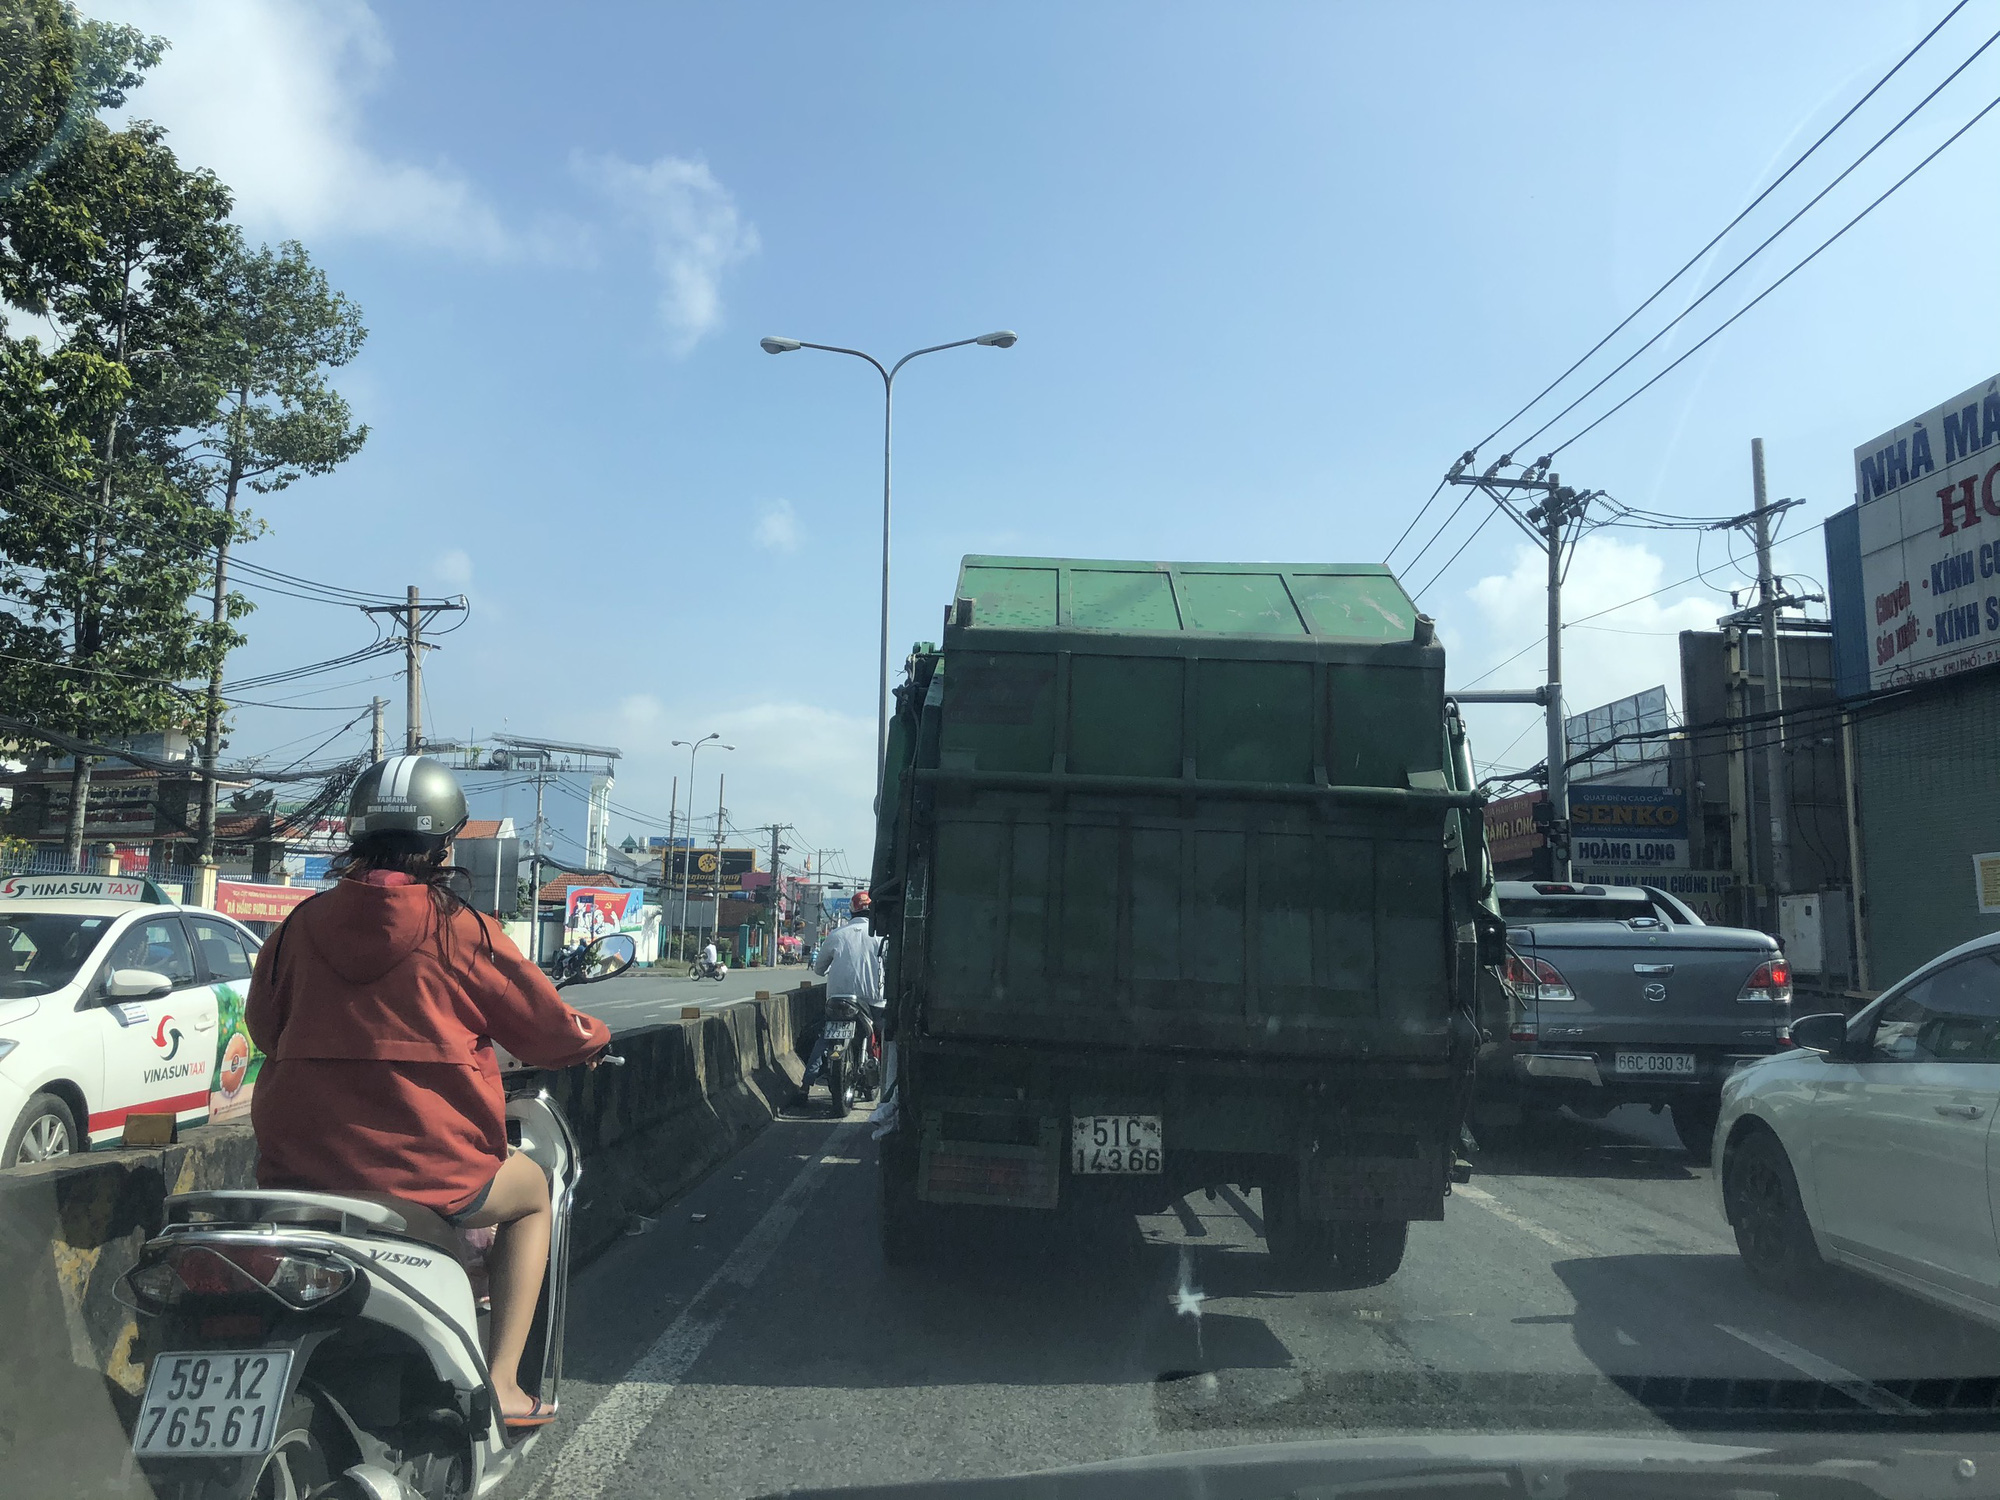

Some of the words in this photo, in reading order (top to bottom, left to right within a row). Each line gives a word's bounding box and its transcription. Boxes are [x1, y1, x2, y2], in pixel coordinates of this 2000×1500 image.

[1860, 421, 1935, 503] NHÀ
[1943, 379, 2000, 464] MÁ
[1931, 552, 1975, 596] KÍNH
[1935, 602, 1980, 646] KÍNH
[1985, 596, 2000, 631] S
[377, 796, 408, 804] YAMAHA
[1572, 804, 1679, 826] SENKO
[1485, 817, 1509, 842] OÀNG
[1511, 815, 1537, 837] LONG
[1579, 839, 1631, 860] HOÀNG
[1636, 843, 1676, 860] LONG
[32, 882, 102, 896] VINASUN
[107, 882, 140, 896] TAXI
[1670, 873, 1708, 893] CƯỜNG
[1619, 1055, 1692, 1071] 66C-030.34
[1093, 1119, 1141, 1147] 51C
[369, 1249, 432, 1268] VISION
[167, 1358, 270, 1400] 59-X2
[141, 1405, 266, 1448] 765.61
